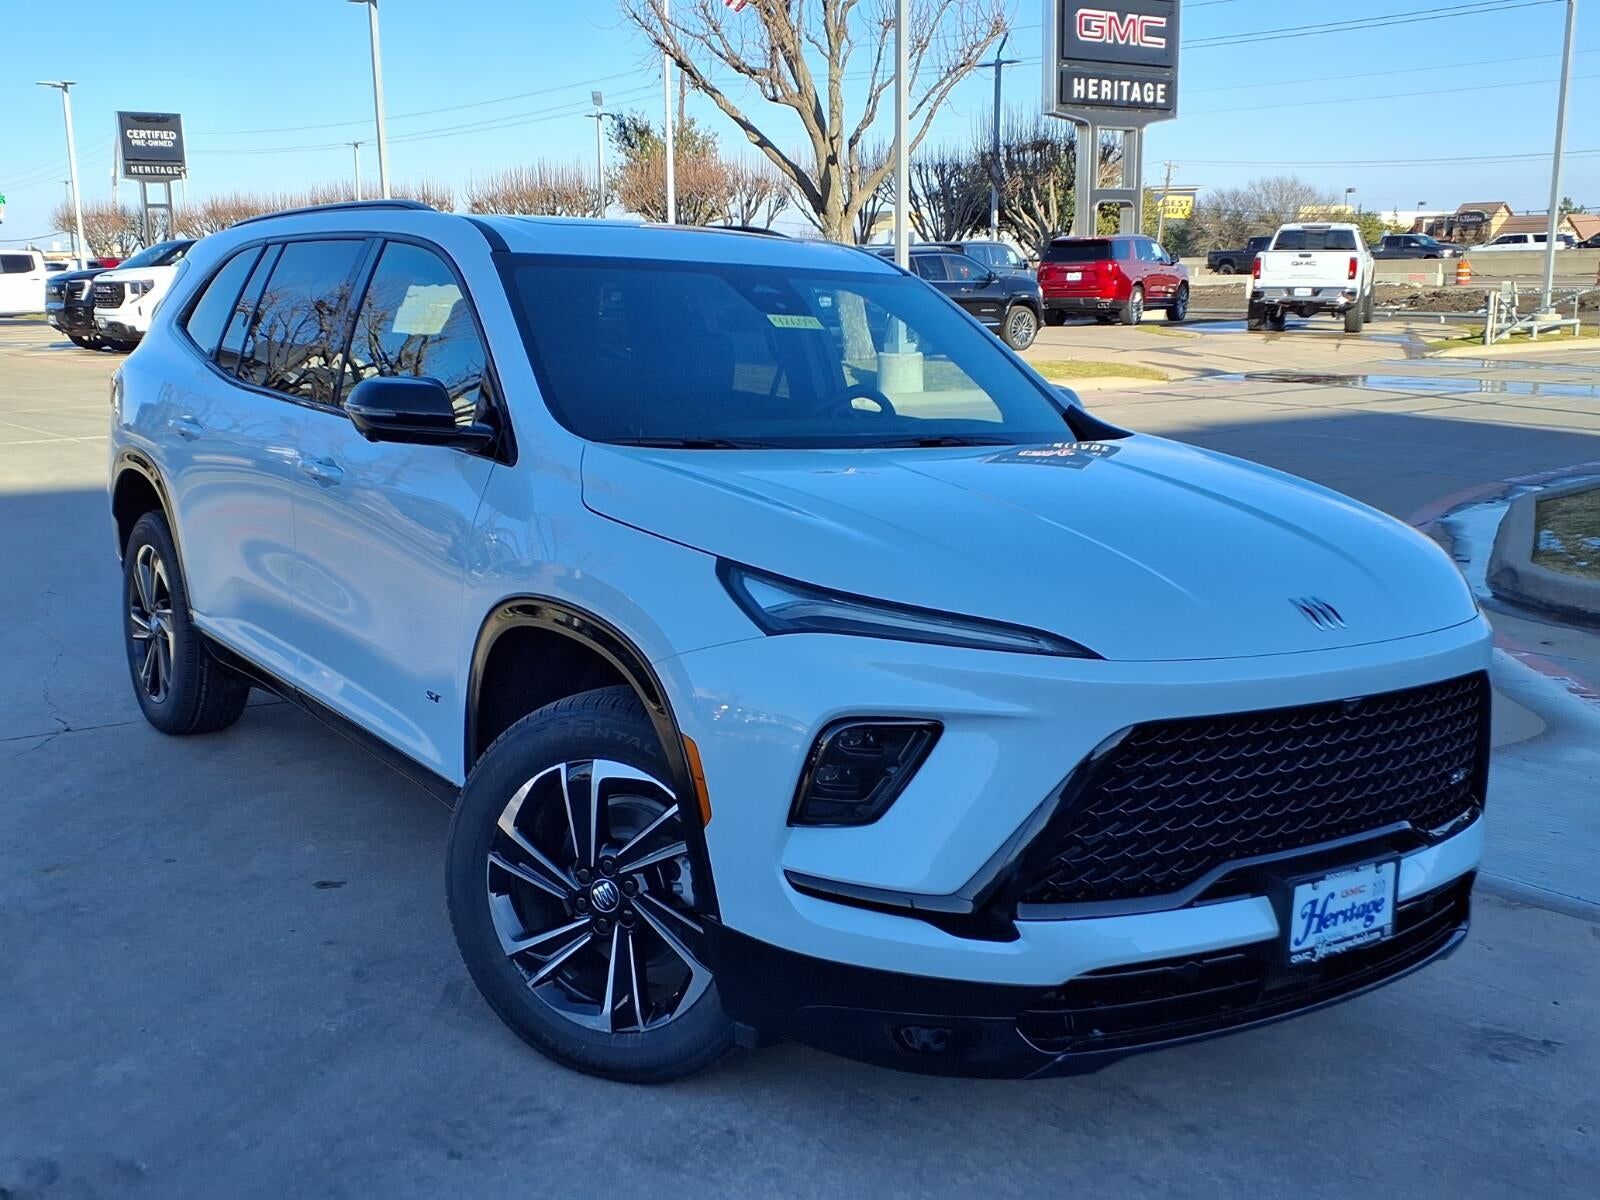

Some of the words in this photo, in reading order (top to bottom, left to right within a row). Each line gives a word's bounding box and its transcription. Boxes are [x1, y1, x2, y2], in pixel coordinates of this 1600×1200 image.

[1076, 8, 1167, 48] GMC
[1073, 77, 1167, 103] HERITAGE
[126, 129, 177, 140] CERTIFIED
[131, 139, 174, 147] PRE-OWNED
[130, 165, 180, 174] HERITAGE
[425, 690, 442, 703] ST
[1294, 892, 1385, 946] Heritage
